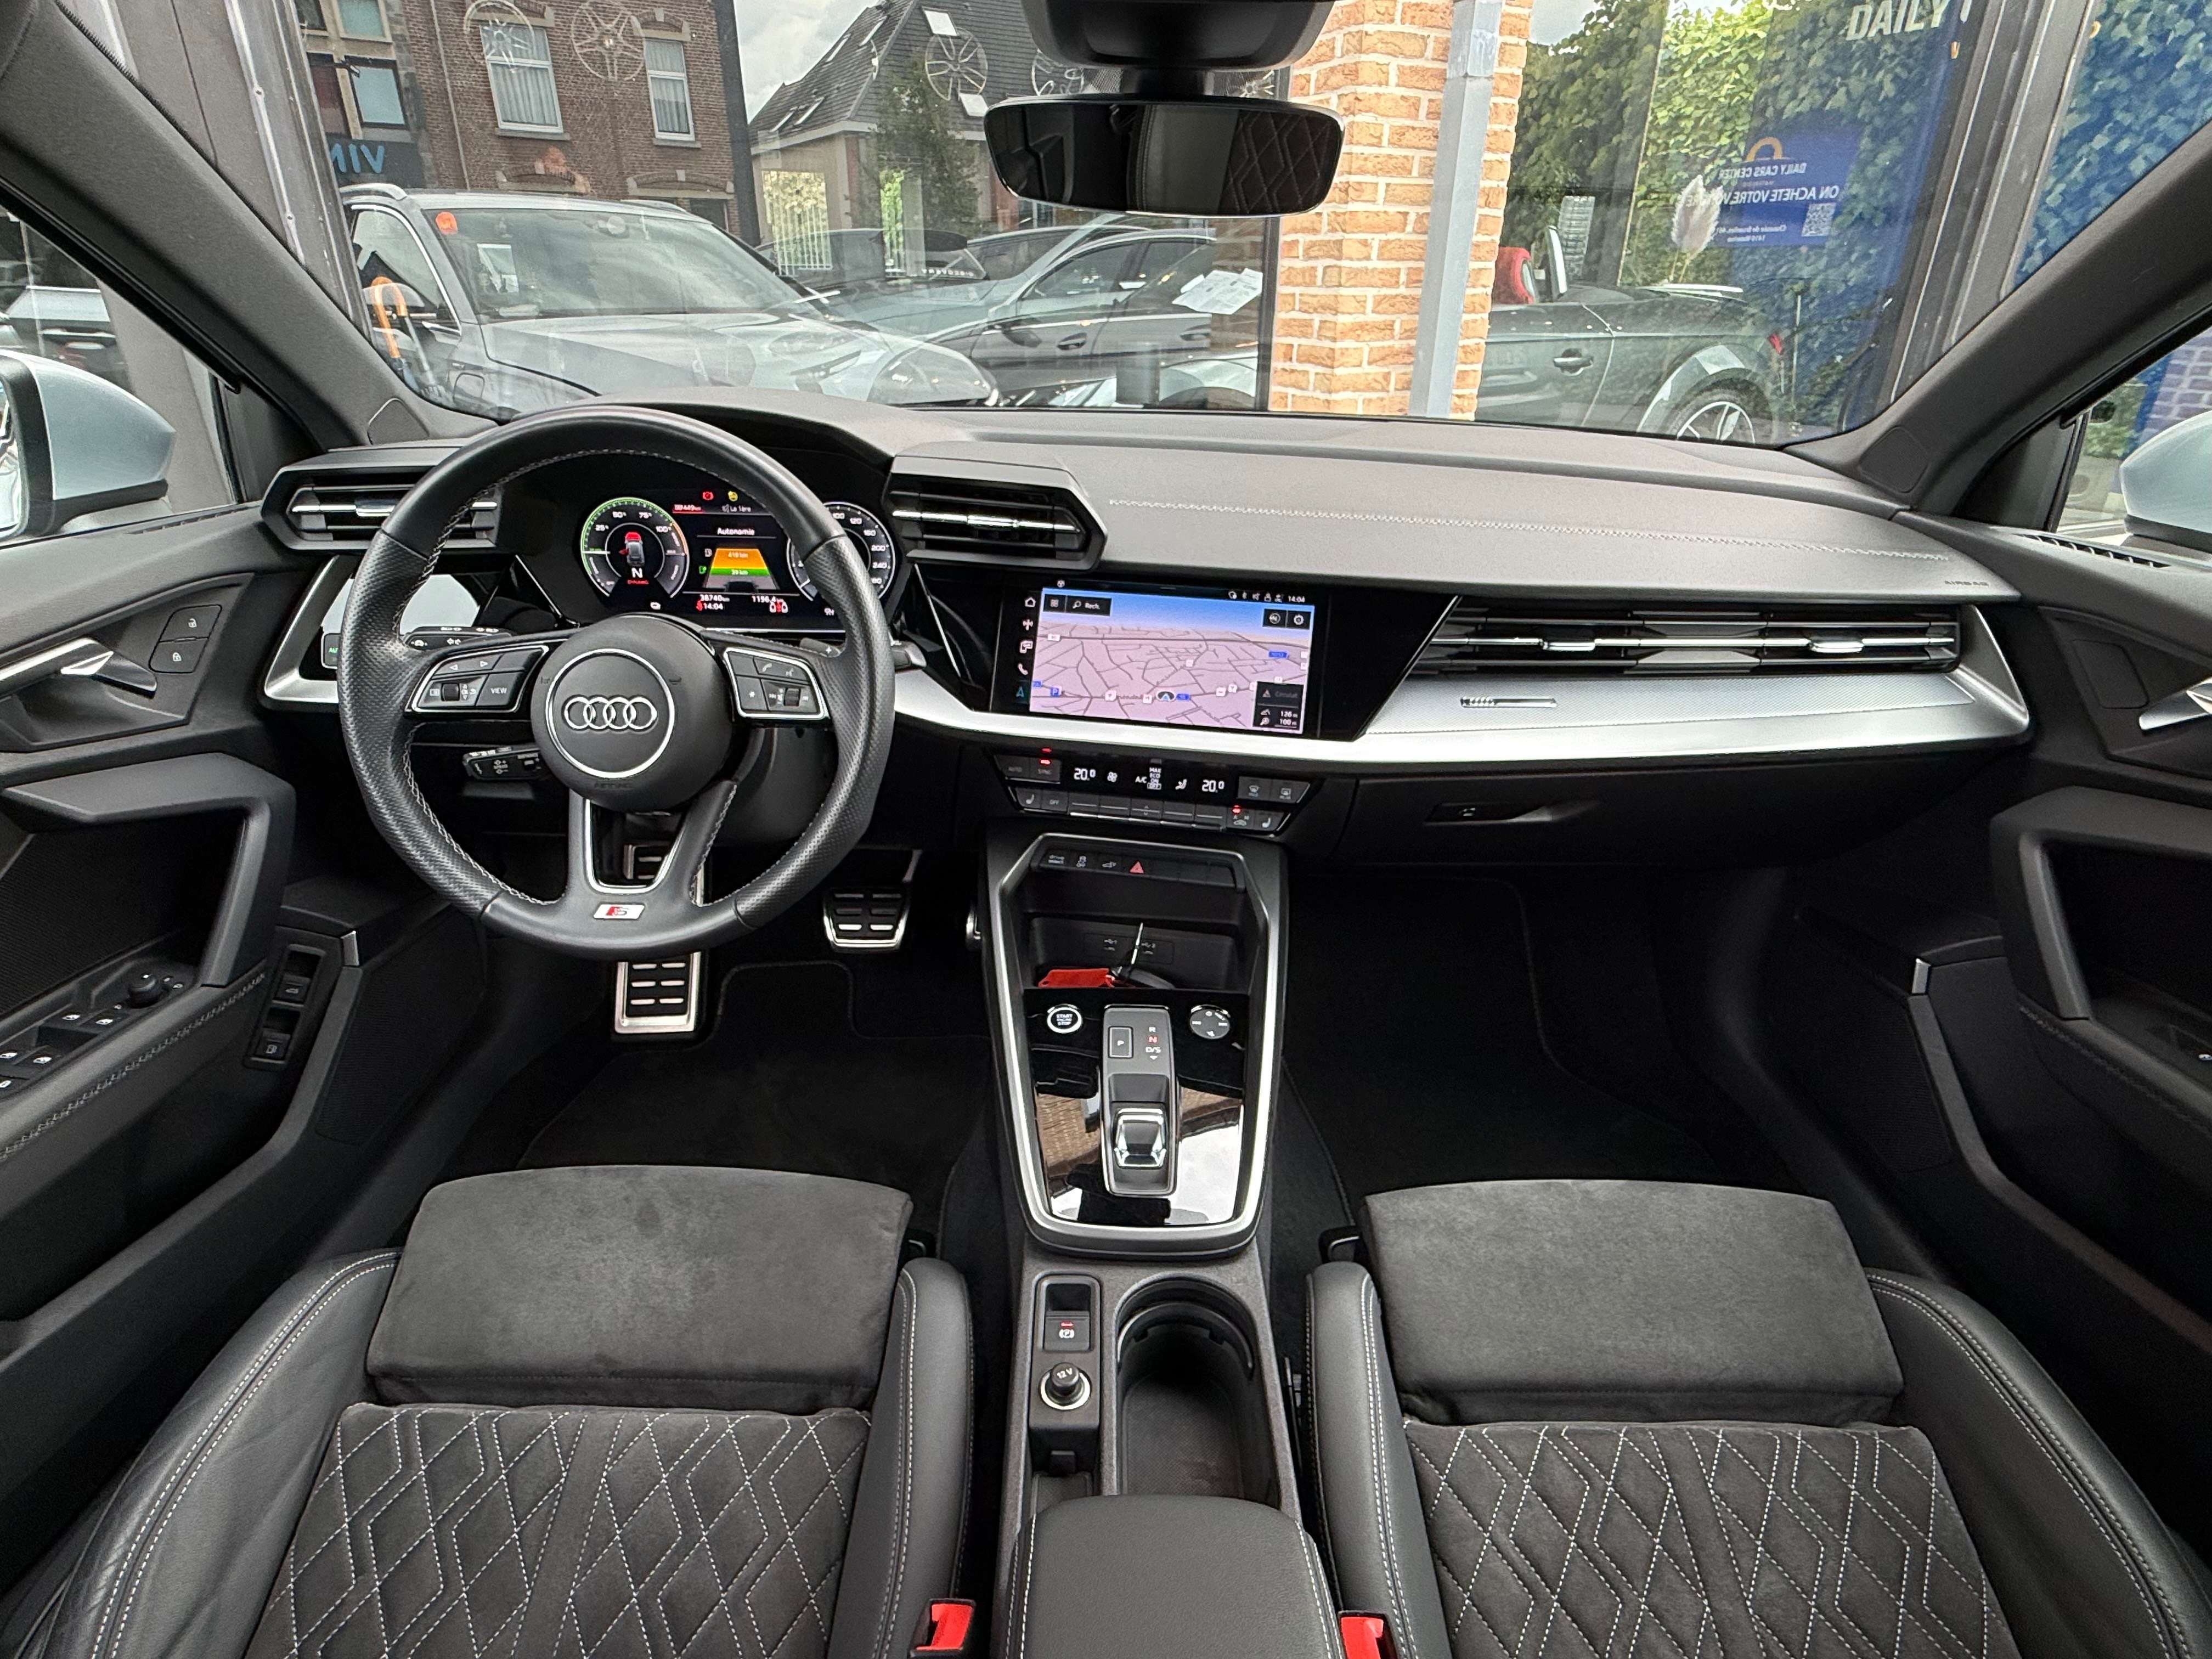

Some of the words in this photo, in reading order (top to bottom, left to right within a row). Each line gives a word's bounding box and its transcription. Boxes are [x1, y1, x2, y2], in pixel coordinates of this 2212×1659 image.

[1844, 0, 1951, 41] DAILY
[717, 527, 755, 535] Autonomie
[631, 568, 643, 578] N
[1135, 776, 1147, 784] A/C
